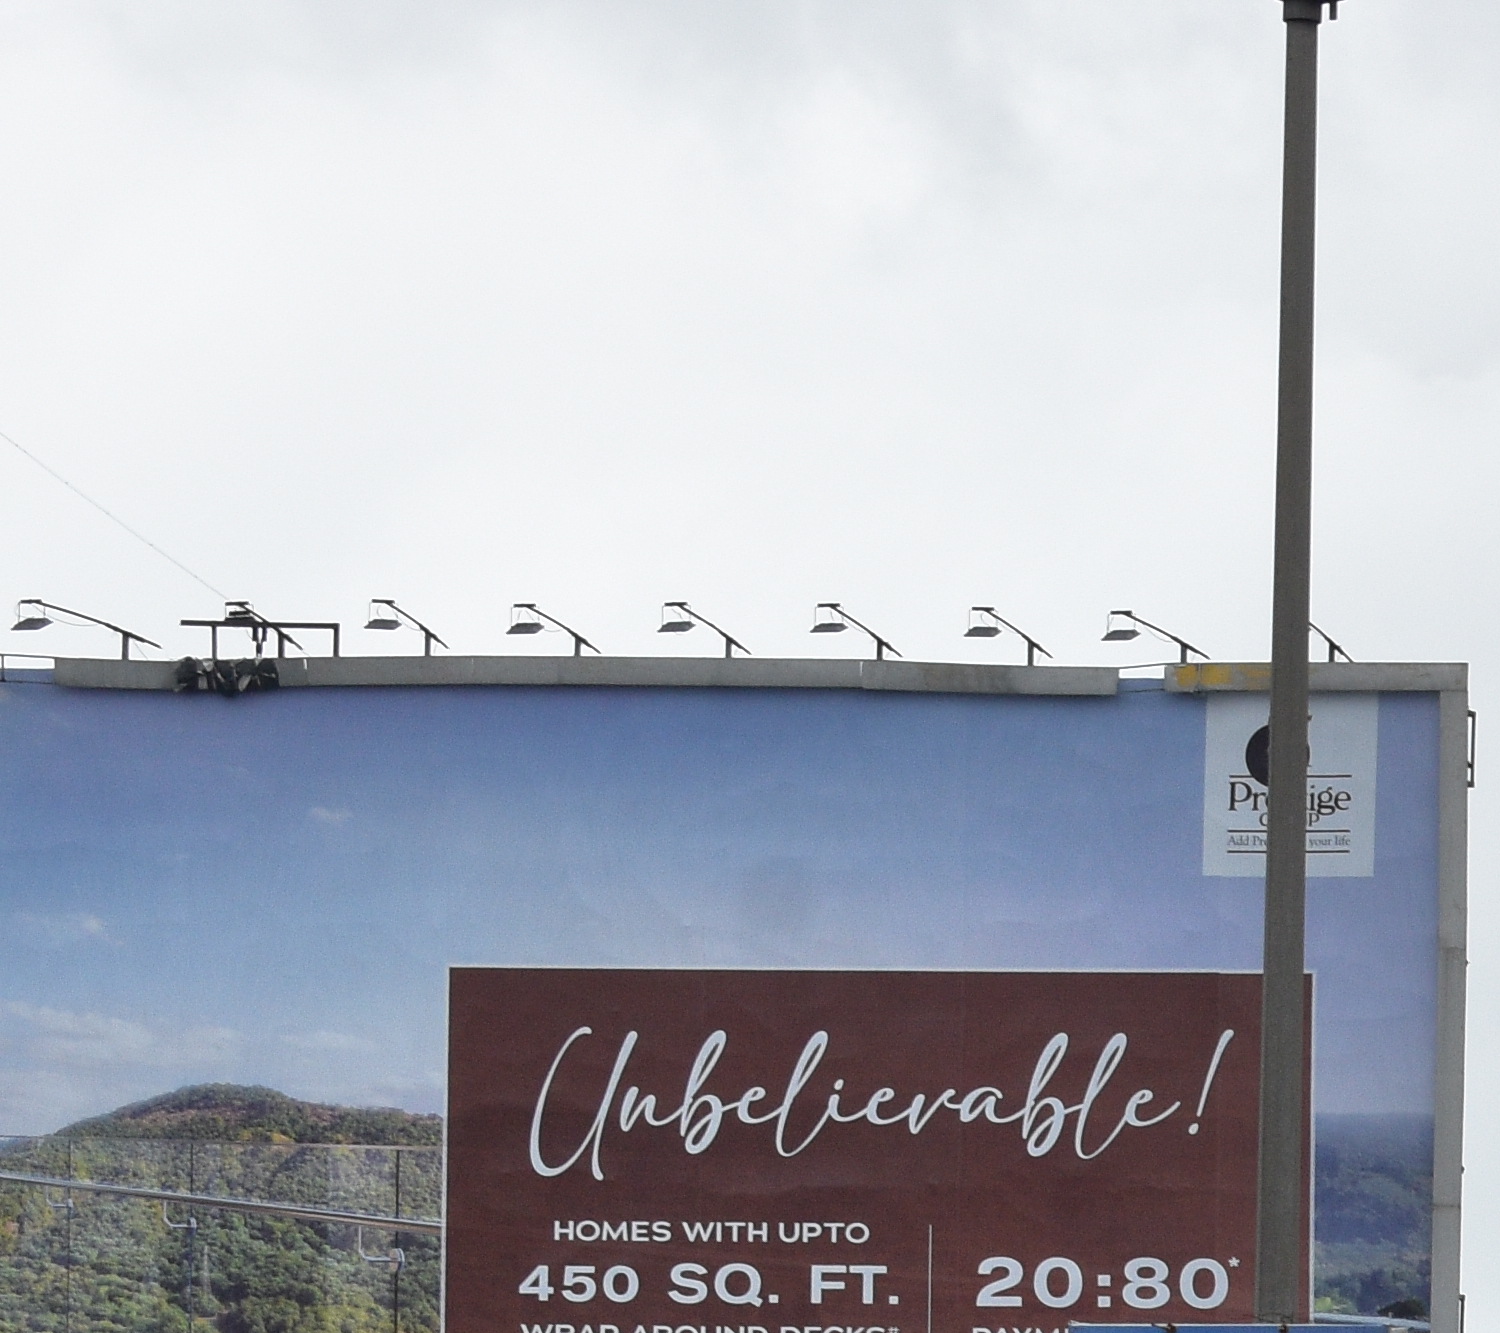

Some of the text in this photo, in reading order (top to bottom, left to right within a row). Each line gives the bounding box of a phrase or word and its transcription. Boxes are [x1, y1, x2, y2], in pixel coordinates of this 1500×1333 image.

[1228, 781, 1352, 816] Prige
[1227, 835, 1249, 846] Add
[1309, 838, 1332, 849] your
[1335, 834, 1350, 846] life
[530, 1026, 1234, 1181] Unbelievable!
[553, 1219, 870, 1245] HOMES WITH UPTO
[518, 1262, 900, 1308] 450 SQ. FT.
